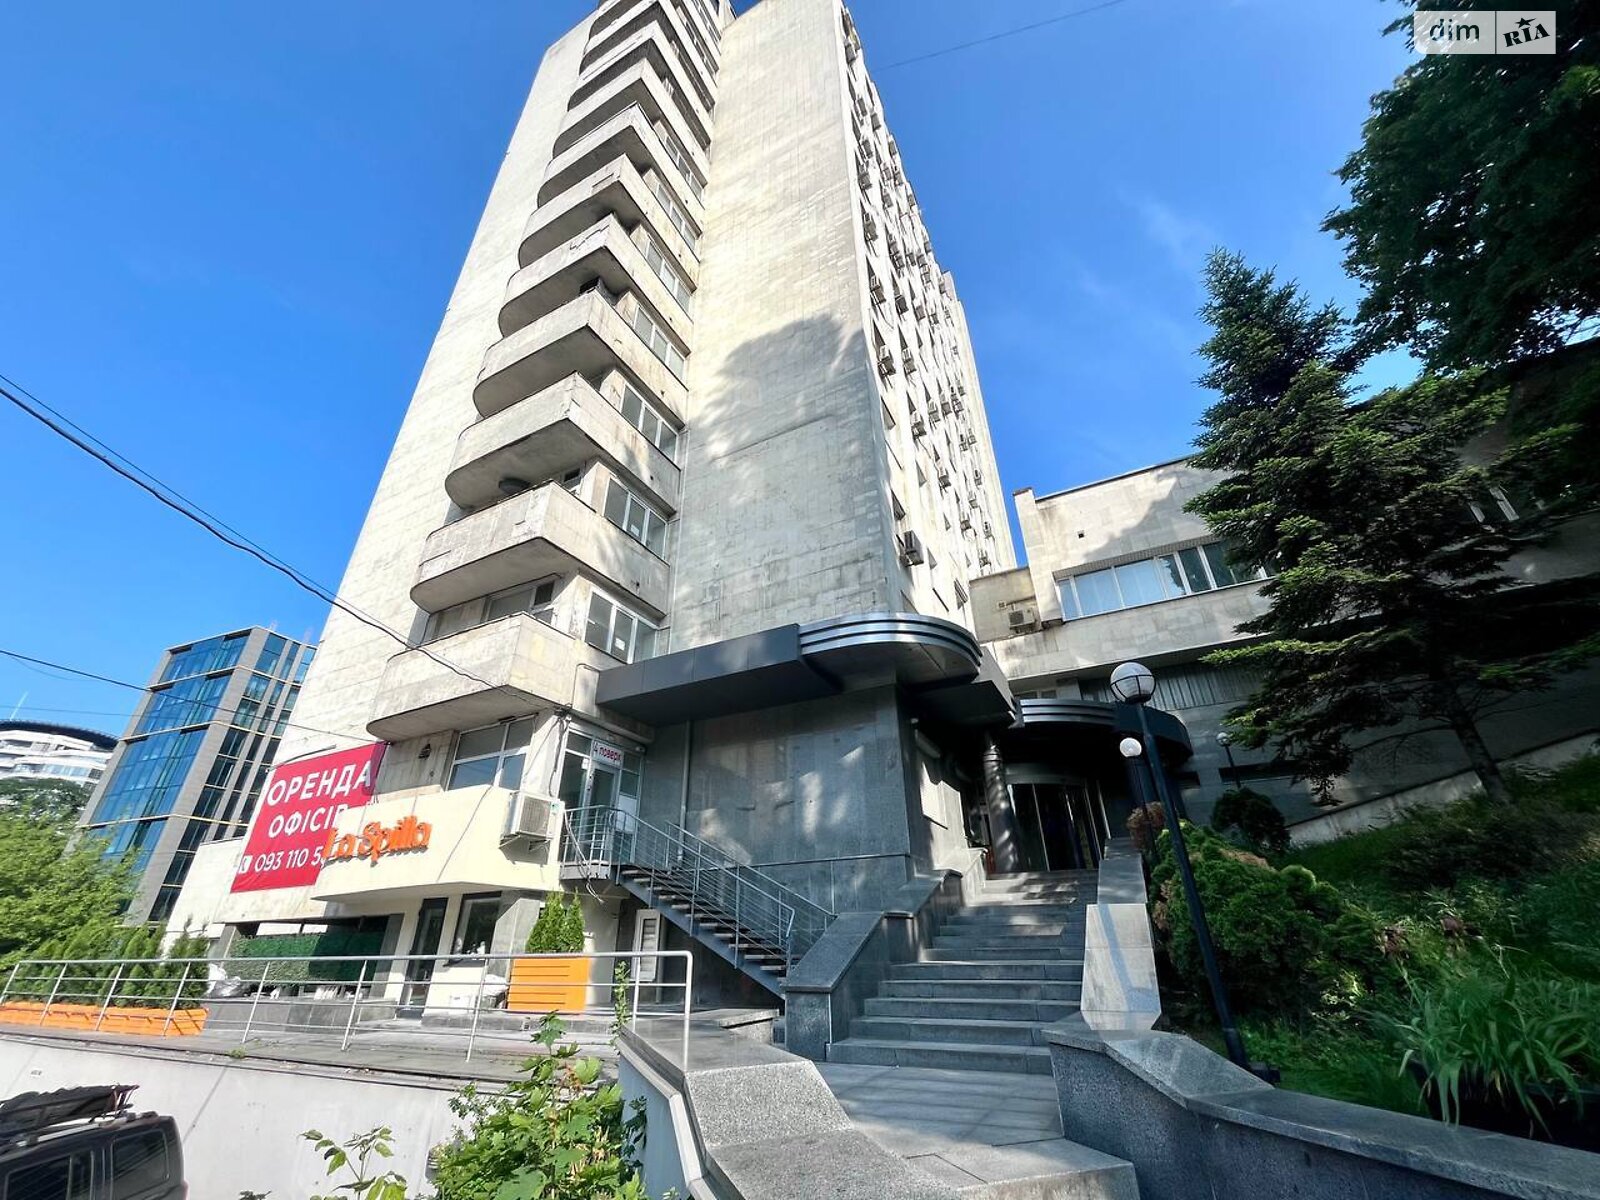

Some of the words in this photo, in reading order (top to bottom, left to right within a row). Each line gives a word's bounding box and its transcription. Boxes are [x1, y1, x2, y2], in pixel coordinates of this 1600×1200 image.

[267, 761, 372, 807] ОРЕНДА
[254, 851, 285, 873] 093
[286, 848, 310, 869] 110
[310, 845, 325, 870] 5
